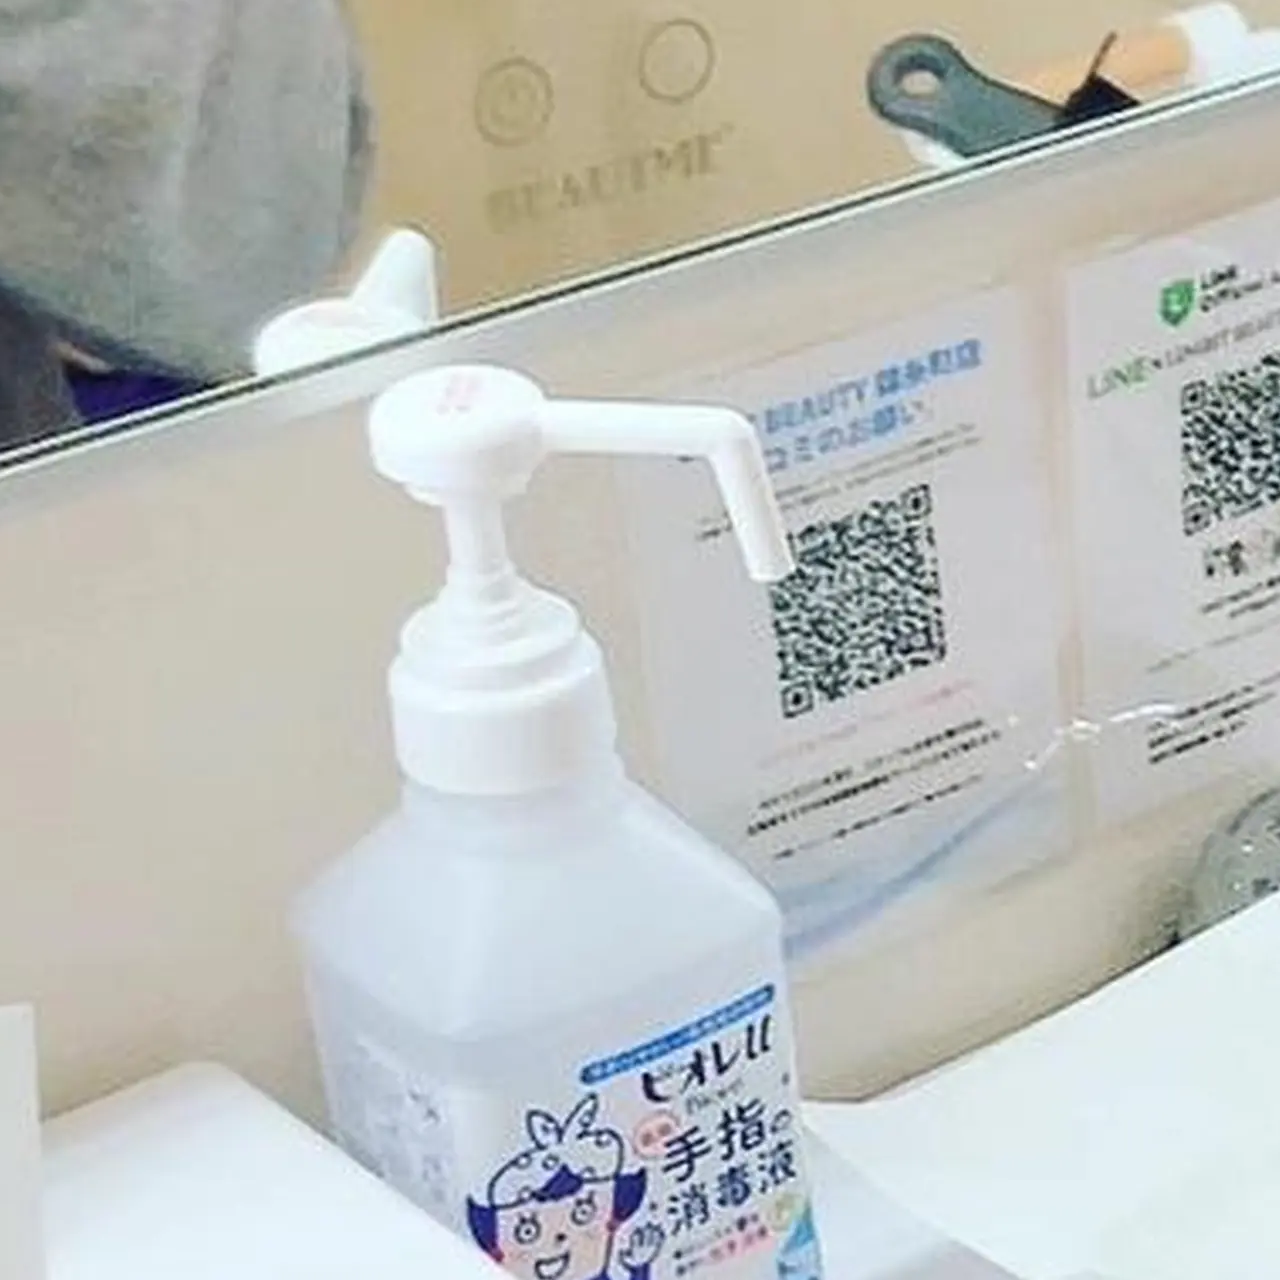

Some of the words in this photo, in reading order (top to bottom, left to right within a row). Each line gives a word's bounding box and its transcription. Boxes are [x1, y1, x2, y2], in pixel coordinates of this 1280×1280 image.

[662, 1096, 794, 1184] 手指の
[668, 1144, 798, 1236] 消毒液
